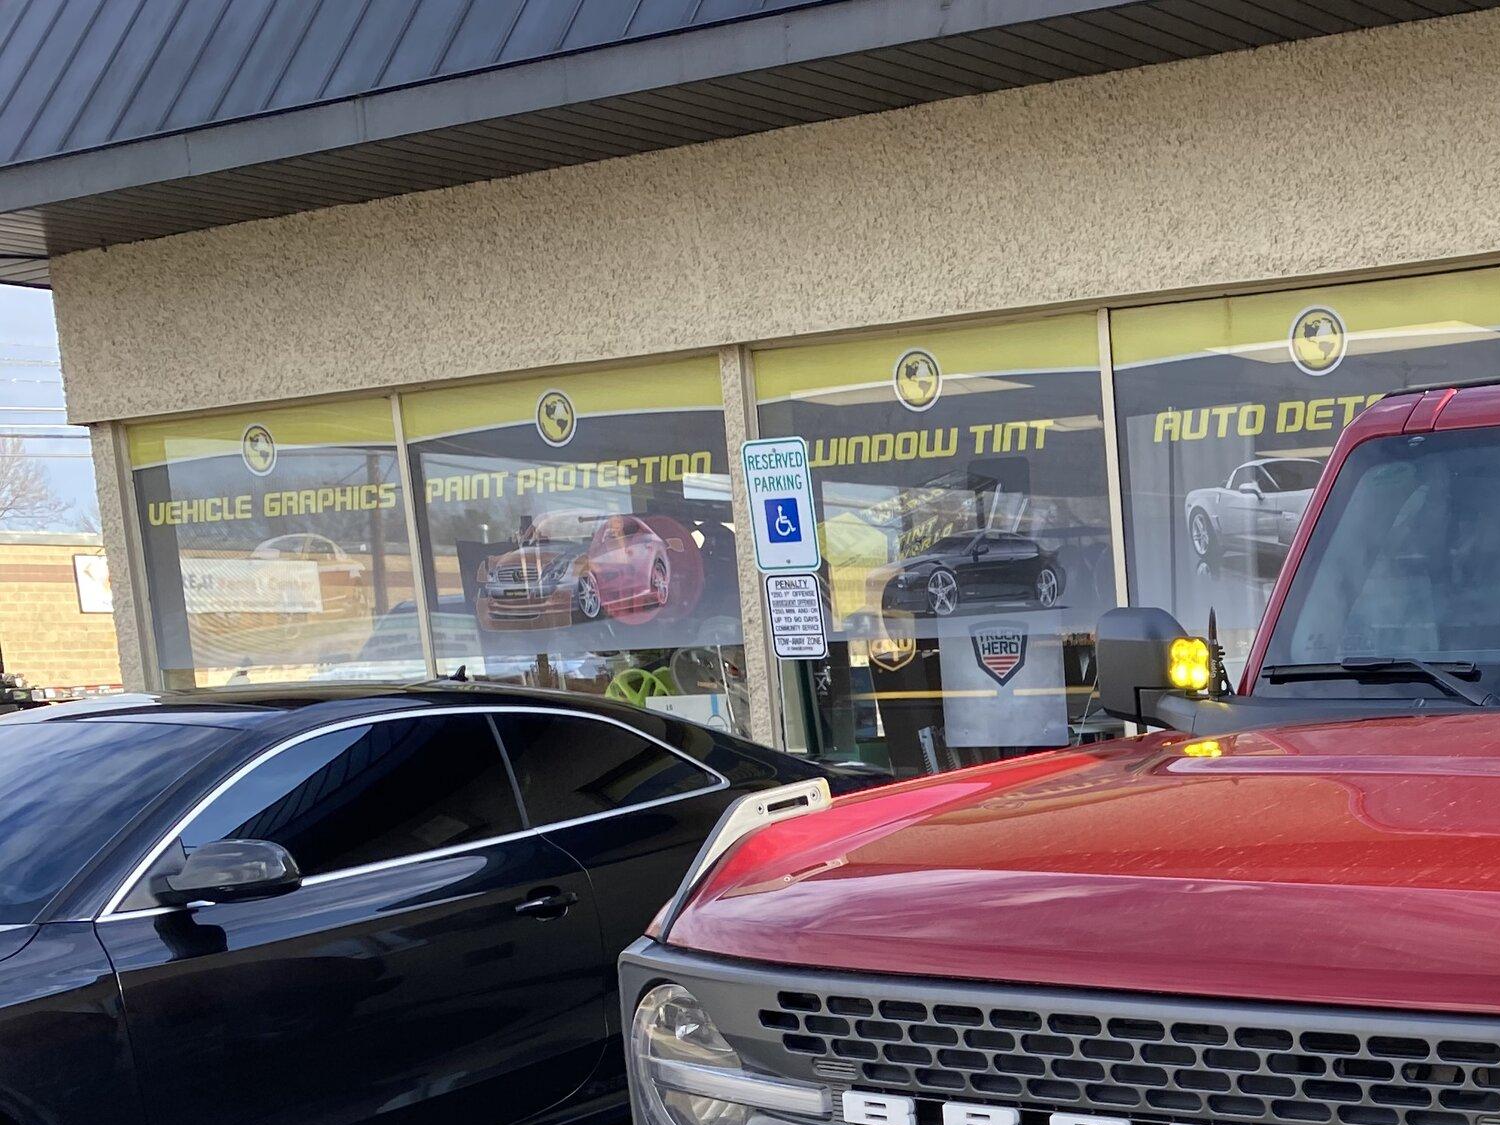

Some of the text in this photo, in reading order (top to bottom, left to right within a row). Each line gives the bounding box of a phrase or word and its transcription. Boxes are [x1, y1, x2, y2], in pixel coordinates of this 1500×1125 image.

[1154, 404, 1266, 443] AUTO
[808, 419, 1054, 468] WINDOW TINT
[747, 452, 803, 471] RESERVED
[425, 451, 711, 503] PAINT PROTECTION
[754, 474, 802, 493] PARKING
[148, 482, 397, 526] VEHICLE GRAPHICS
[775, 580, 809, 589] PENALTY
[807, 637, 822, 645] ZONE
[982, 641, 1019, 655] HERD
